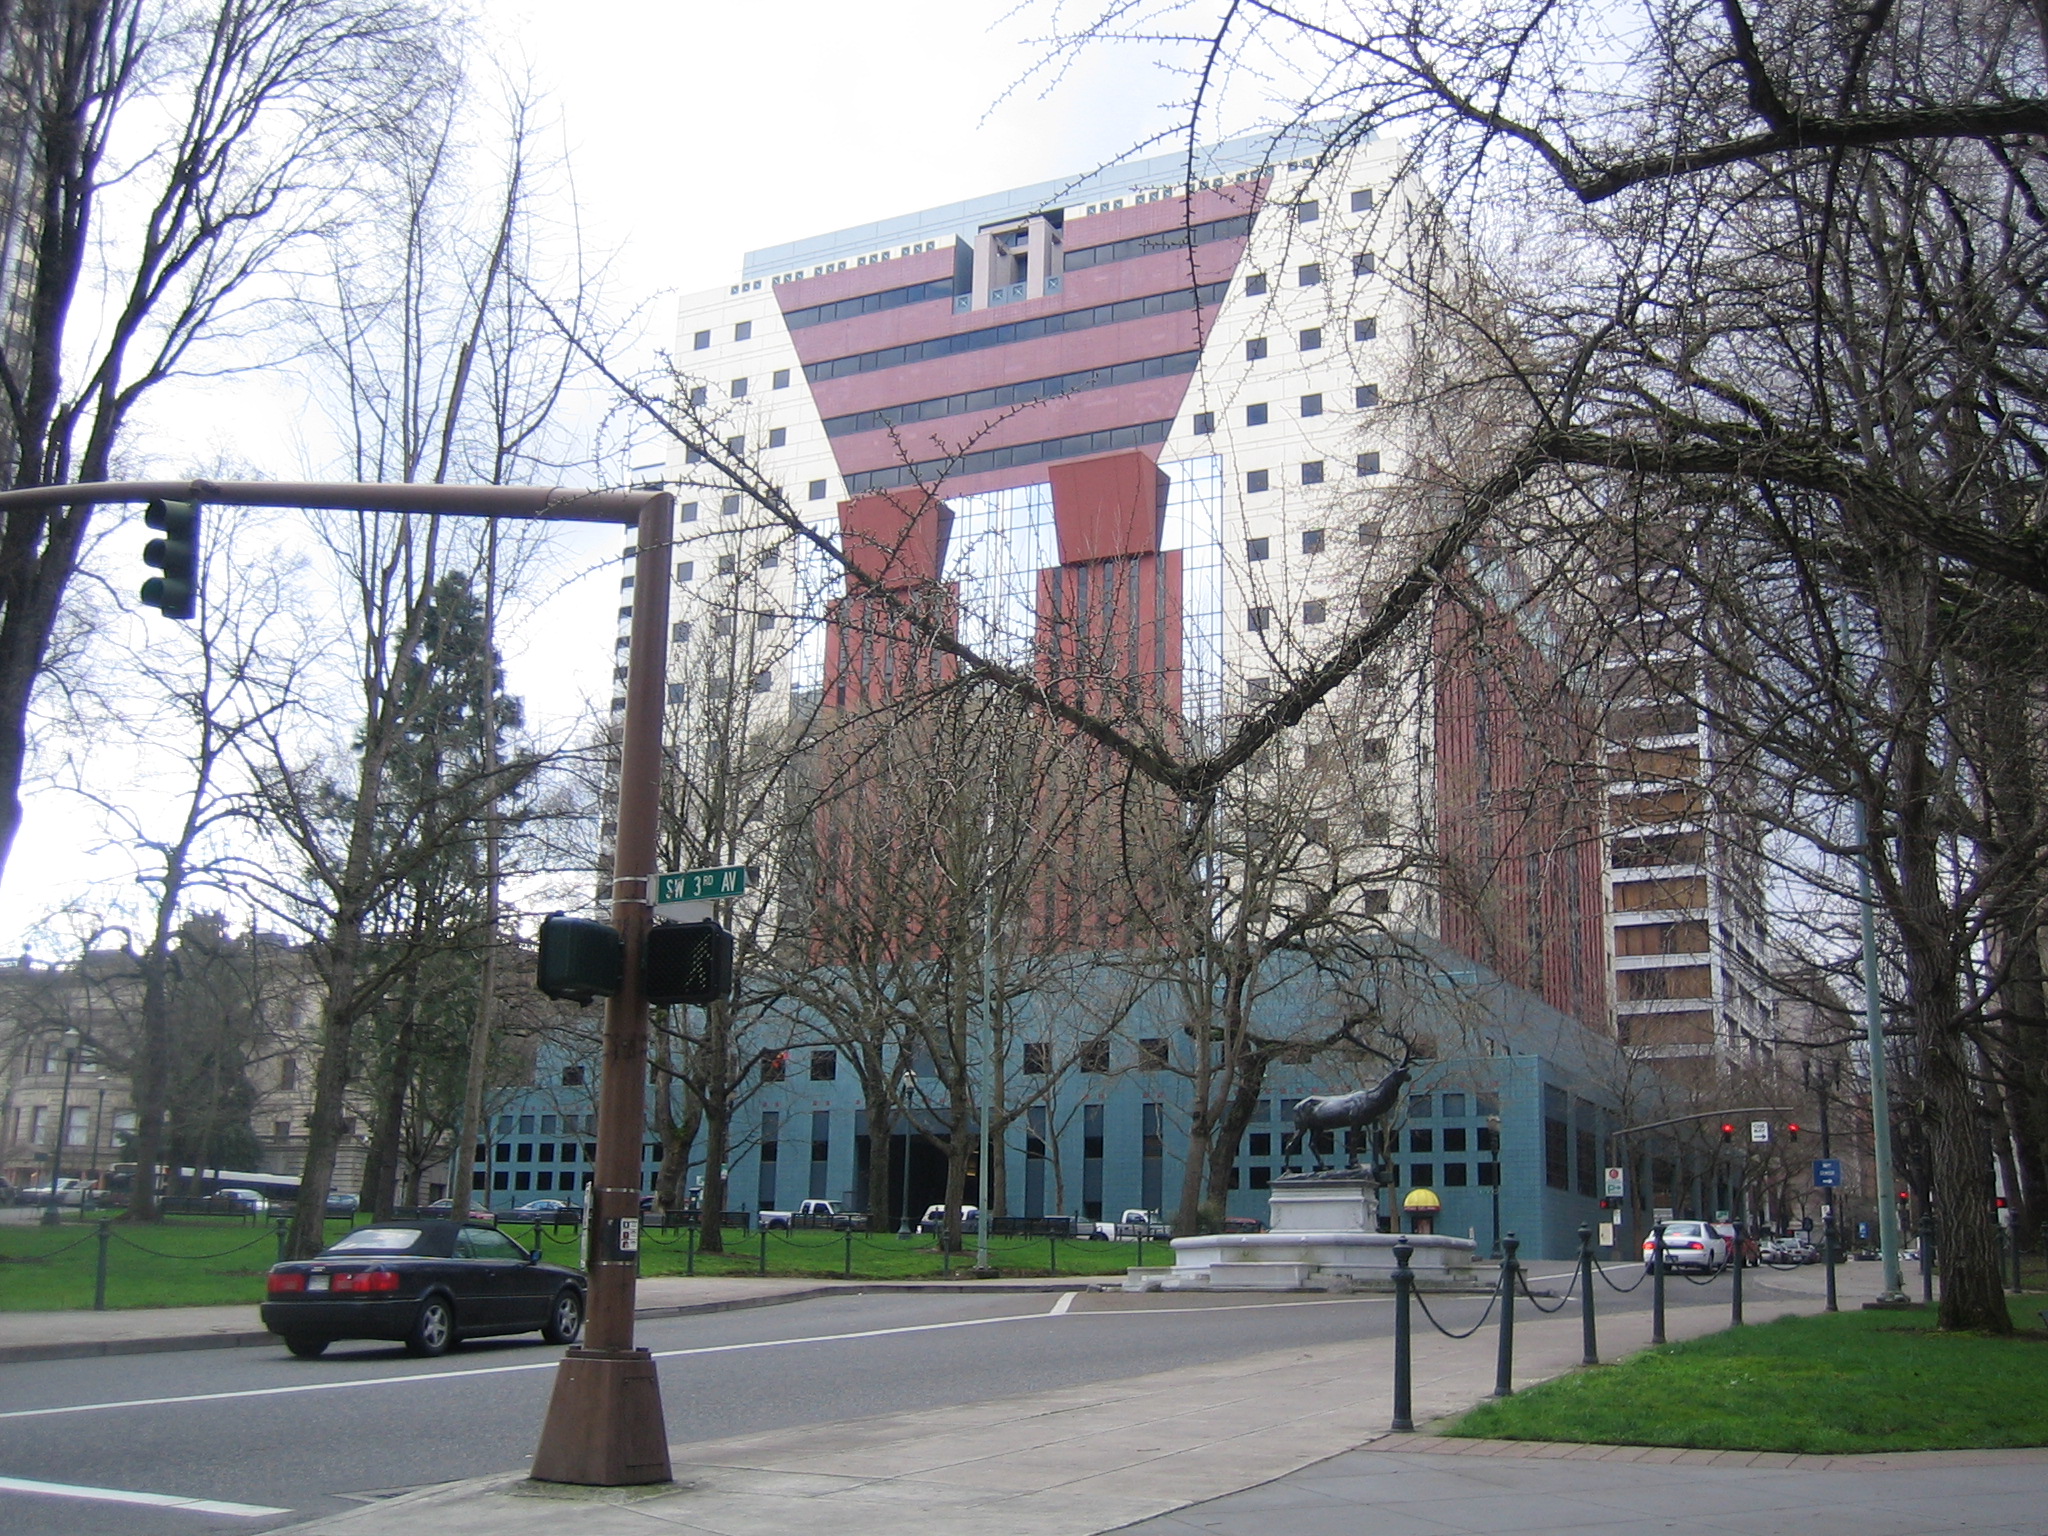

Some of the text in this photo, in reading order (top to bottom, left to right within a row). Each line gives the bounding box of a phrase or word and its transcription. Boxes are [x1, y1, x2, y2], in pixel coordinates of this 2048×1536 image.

[666, 871, 737, 899] SW 3RD AV
